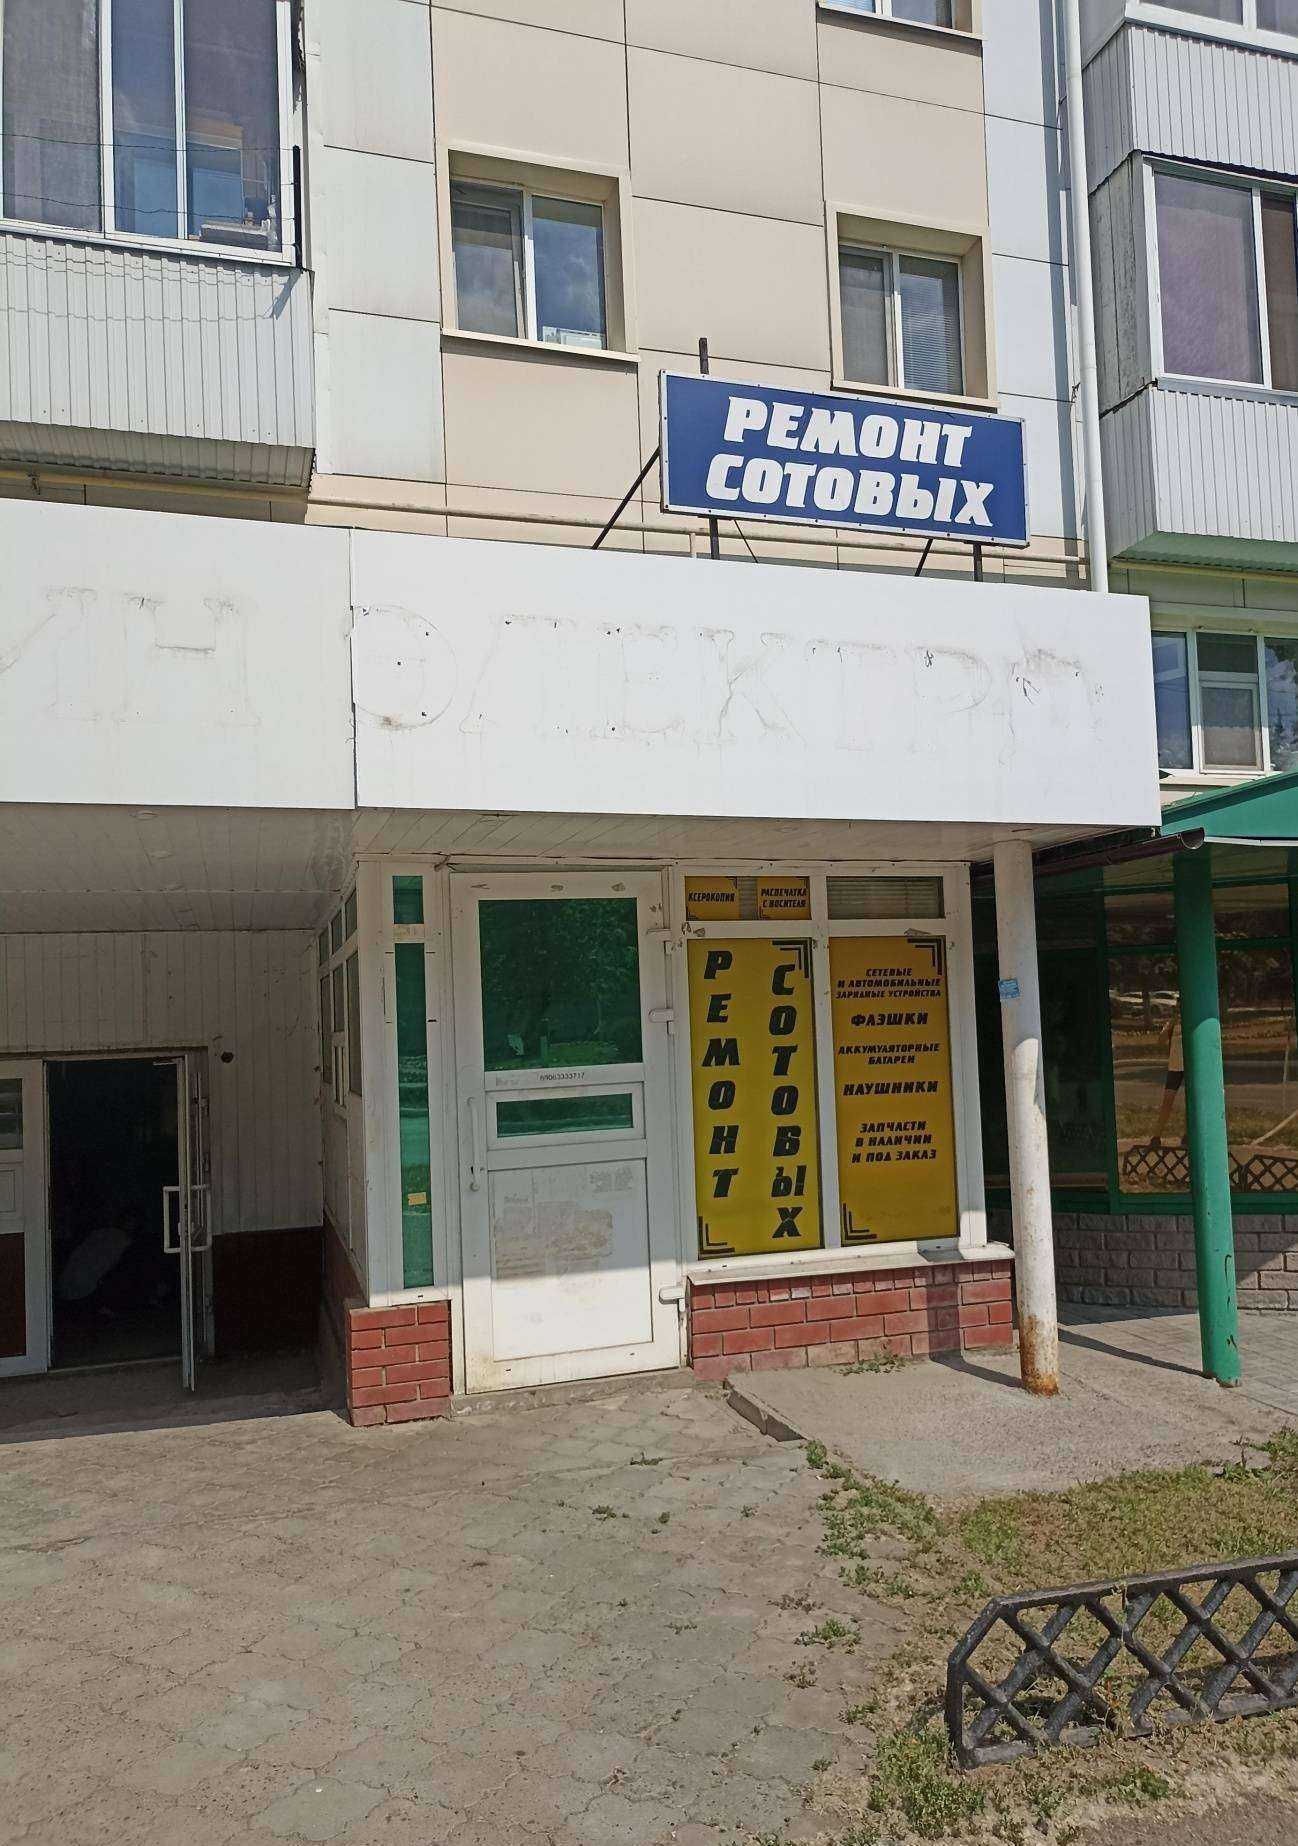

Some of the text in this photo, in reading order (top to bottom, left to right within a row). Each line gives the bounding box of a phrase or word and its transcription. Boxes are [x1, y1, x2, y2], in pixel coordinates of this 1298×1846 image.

[723, 396, 972, 468] РЕМОНТ
[705, 453, 995, 527] СОТОВЫХ
[688, 892, 736, 902] КСЕРОКОПИЯ
[761, 888, 808, 897] РАСПЕЧАТКА
[770, 899, 807, 908] НОСИТЕЛЯ
[866, 968, 913, 977] СЕТЕВЫЕ
[837, 978, 941, 989] И АВТОМОБИЛЬНЫЕ
[835, 990, 885, 999] ЗАРЯДНЫЕ
[838, 1043, 940, 1055] АККУМУЛЯТОРНЫЕ
[701, 950, 741, 1198] РЕМОНТ
[842, 1080, 939, 1096] НАУШНИКИ
[768, 963, 808, 1239] СОТОВЫХ
[860, 1120, 927, 1133] ЗАПЧАСТИ
[855, 1133, 932, 1147] В НАЛИЧИИ
[851, 1149, 937, 1164] И ПОД ЗАКАЗ
